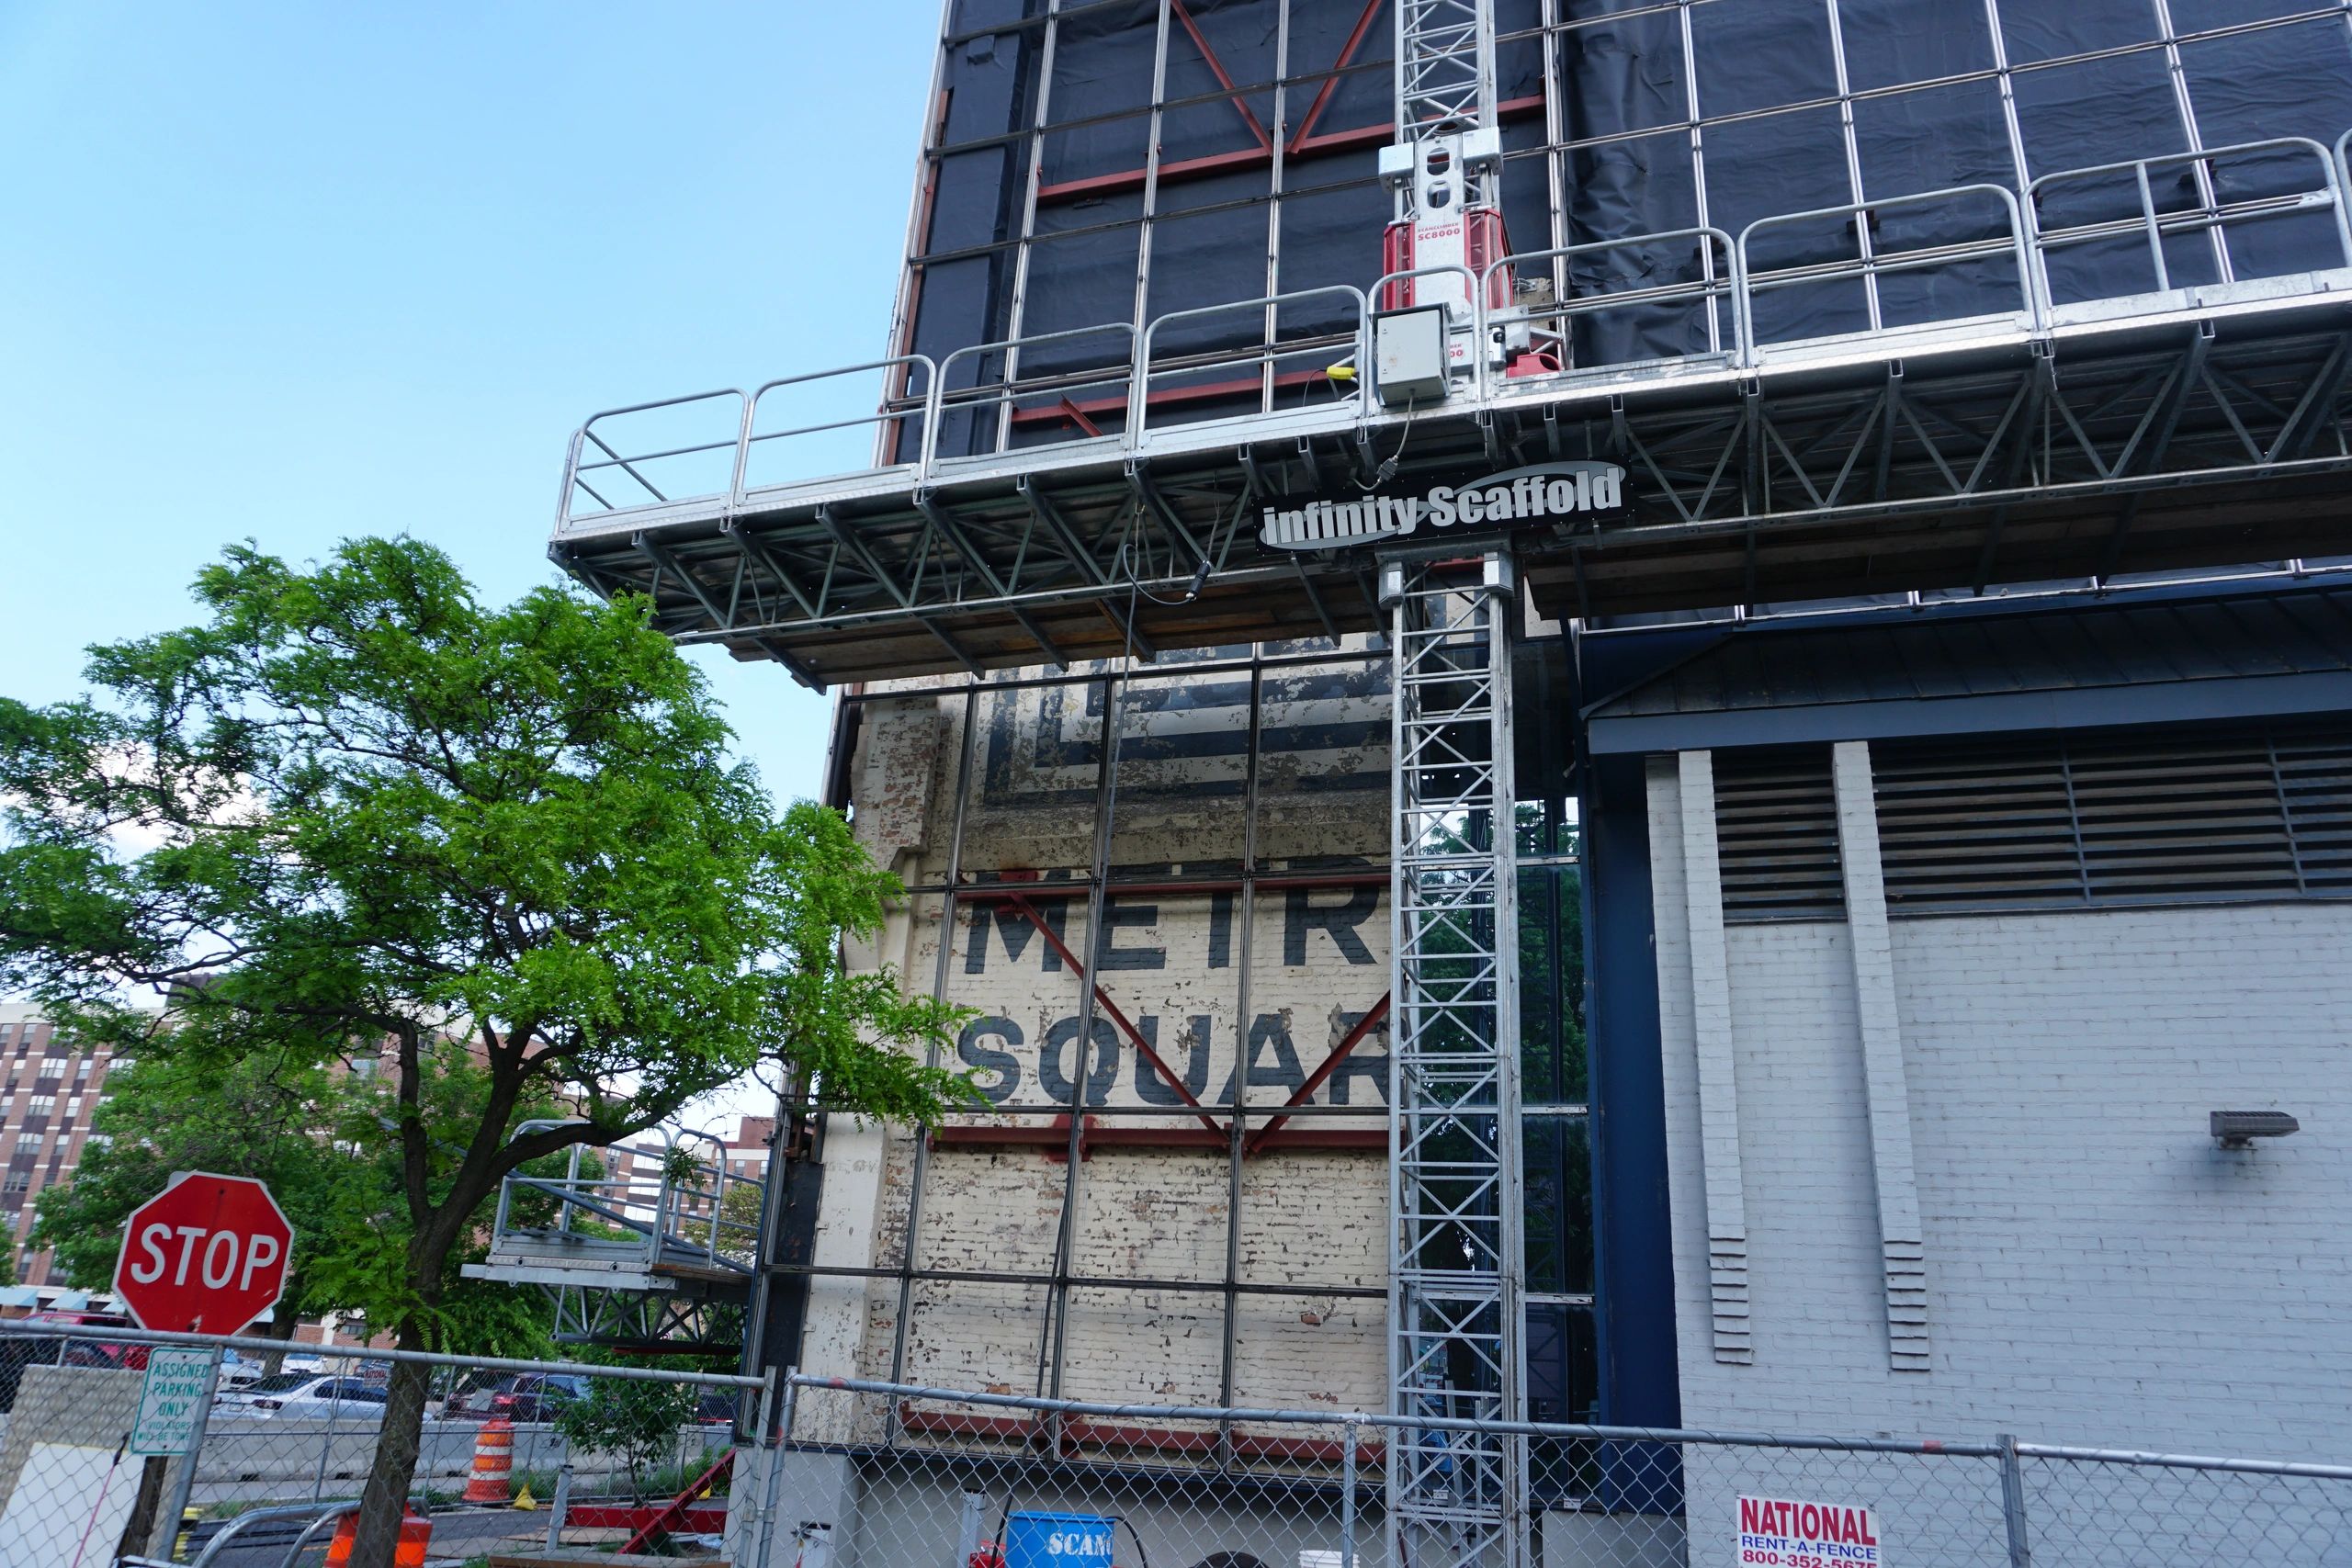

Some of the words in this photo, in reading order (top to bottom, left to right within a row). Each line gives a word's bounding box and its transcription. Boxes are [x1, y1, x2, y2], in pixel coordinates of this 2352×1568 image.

[1418, 228, 1461, 242] SC8000
[1262, 494, 1418, 546] infinity
[1427, 466, 1623, 527] Scaffold
[130, 1223, 279, 1291] STOP
[153, 1362, 209, 1378] ASSIGNED
[153, 1381, 203, 1397] PARKING
[158, 1401, 189, 1416] ONLY
[158, 1432, 168, 1441] BE
[1741, 1498, 1877, 1547] NATIONAL
[1742, 1535, 1878, 1561] RENT-A-FENCE
